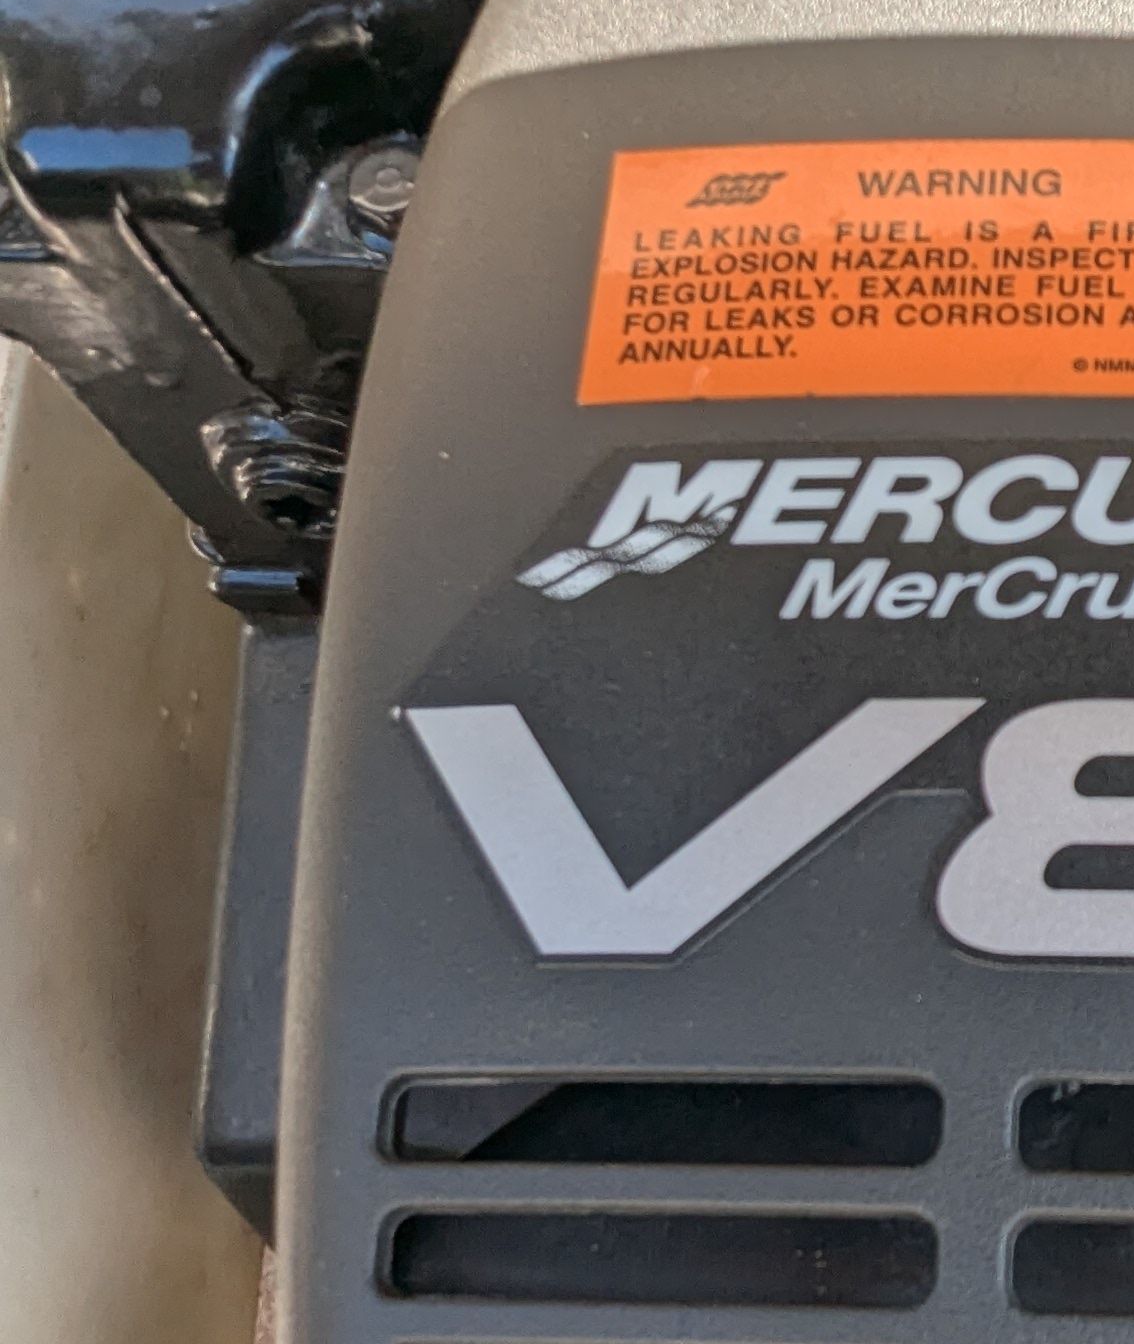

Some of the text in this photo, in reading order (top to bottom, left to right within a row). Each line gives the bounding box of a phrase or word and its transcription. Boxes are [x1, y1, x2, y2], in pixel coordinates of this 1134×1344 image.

[858, 169, 1061, 197] WARNING
[634, 223, 800, 252] LEAKING
[835, 222, 931, 244] FUEL
[964, 220, 999, 242] IS
[1032, 221, 1053, 241] A
[630, 251, 817, 279] EXPLOSION
[831, 247, 977, 271] HAZARD.
[627, 278, 837, 306] REGULARLY.
[860, 275, 1011, 298] EXAMINE
[1038, 276, 1124, 298] FUEL
[623, 311, 688, 335] FOR
[706, 306, 815, 330] LEAKS
[830, 305, 879, 328] OR
[895, 303, 1104, 327] CORROSION
[618, 335, 797, 364] ANNUALLY.
